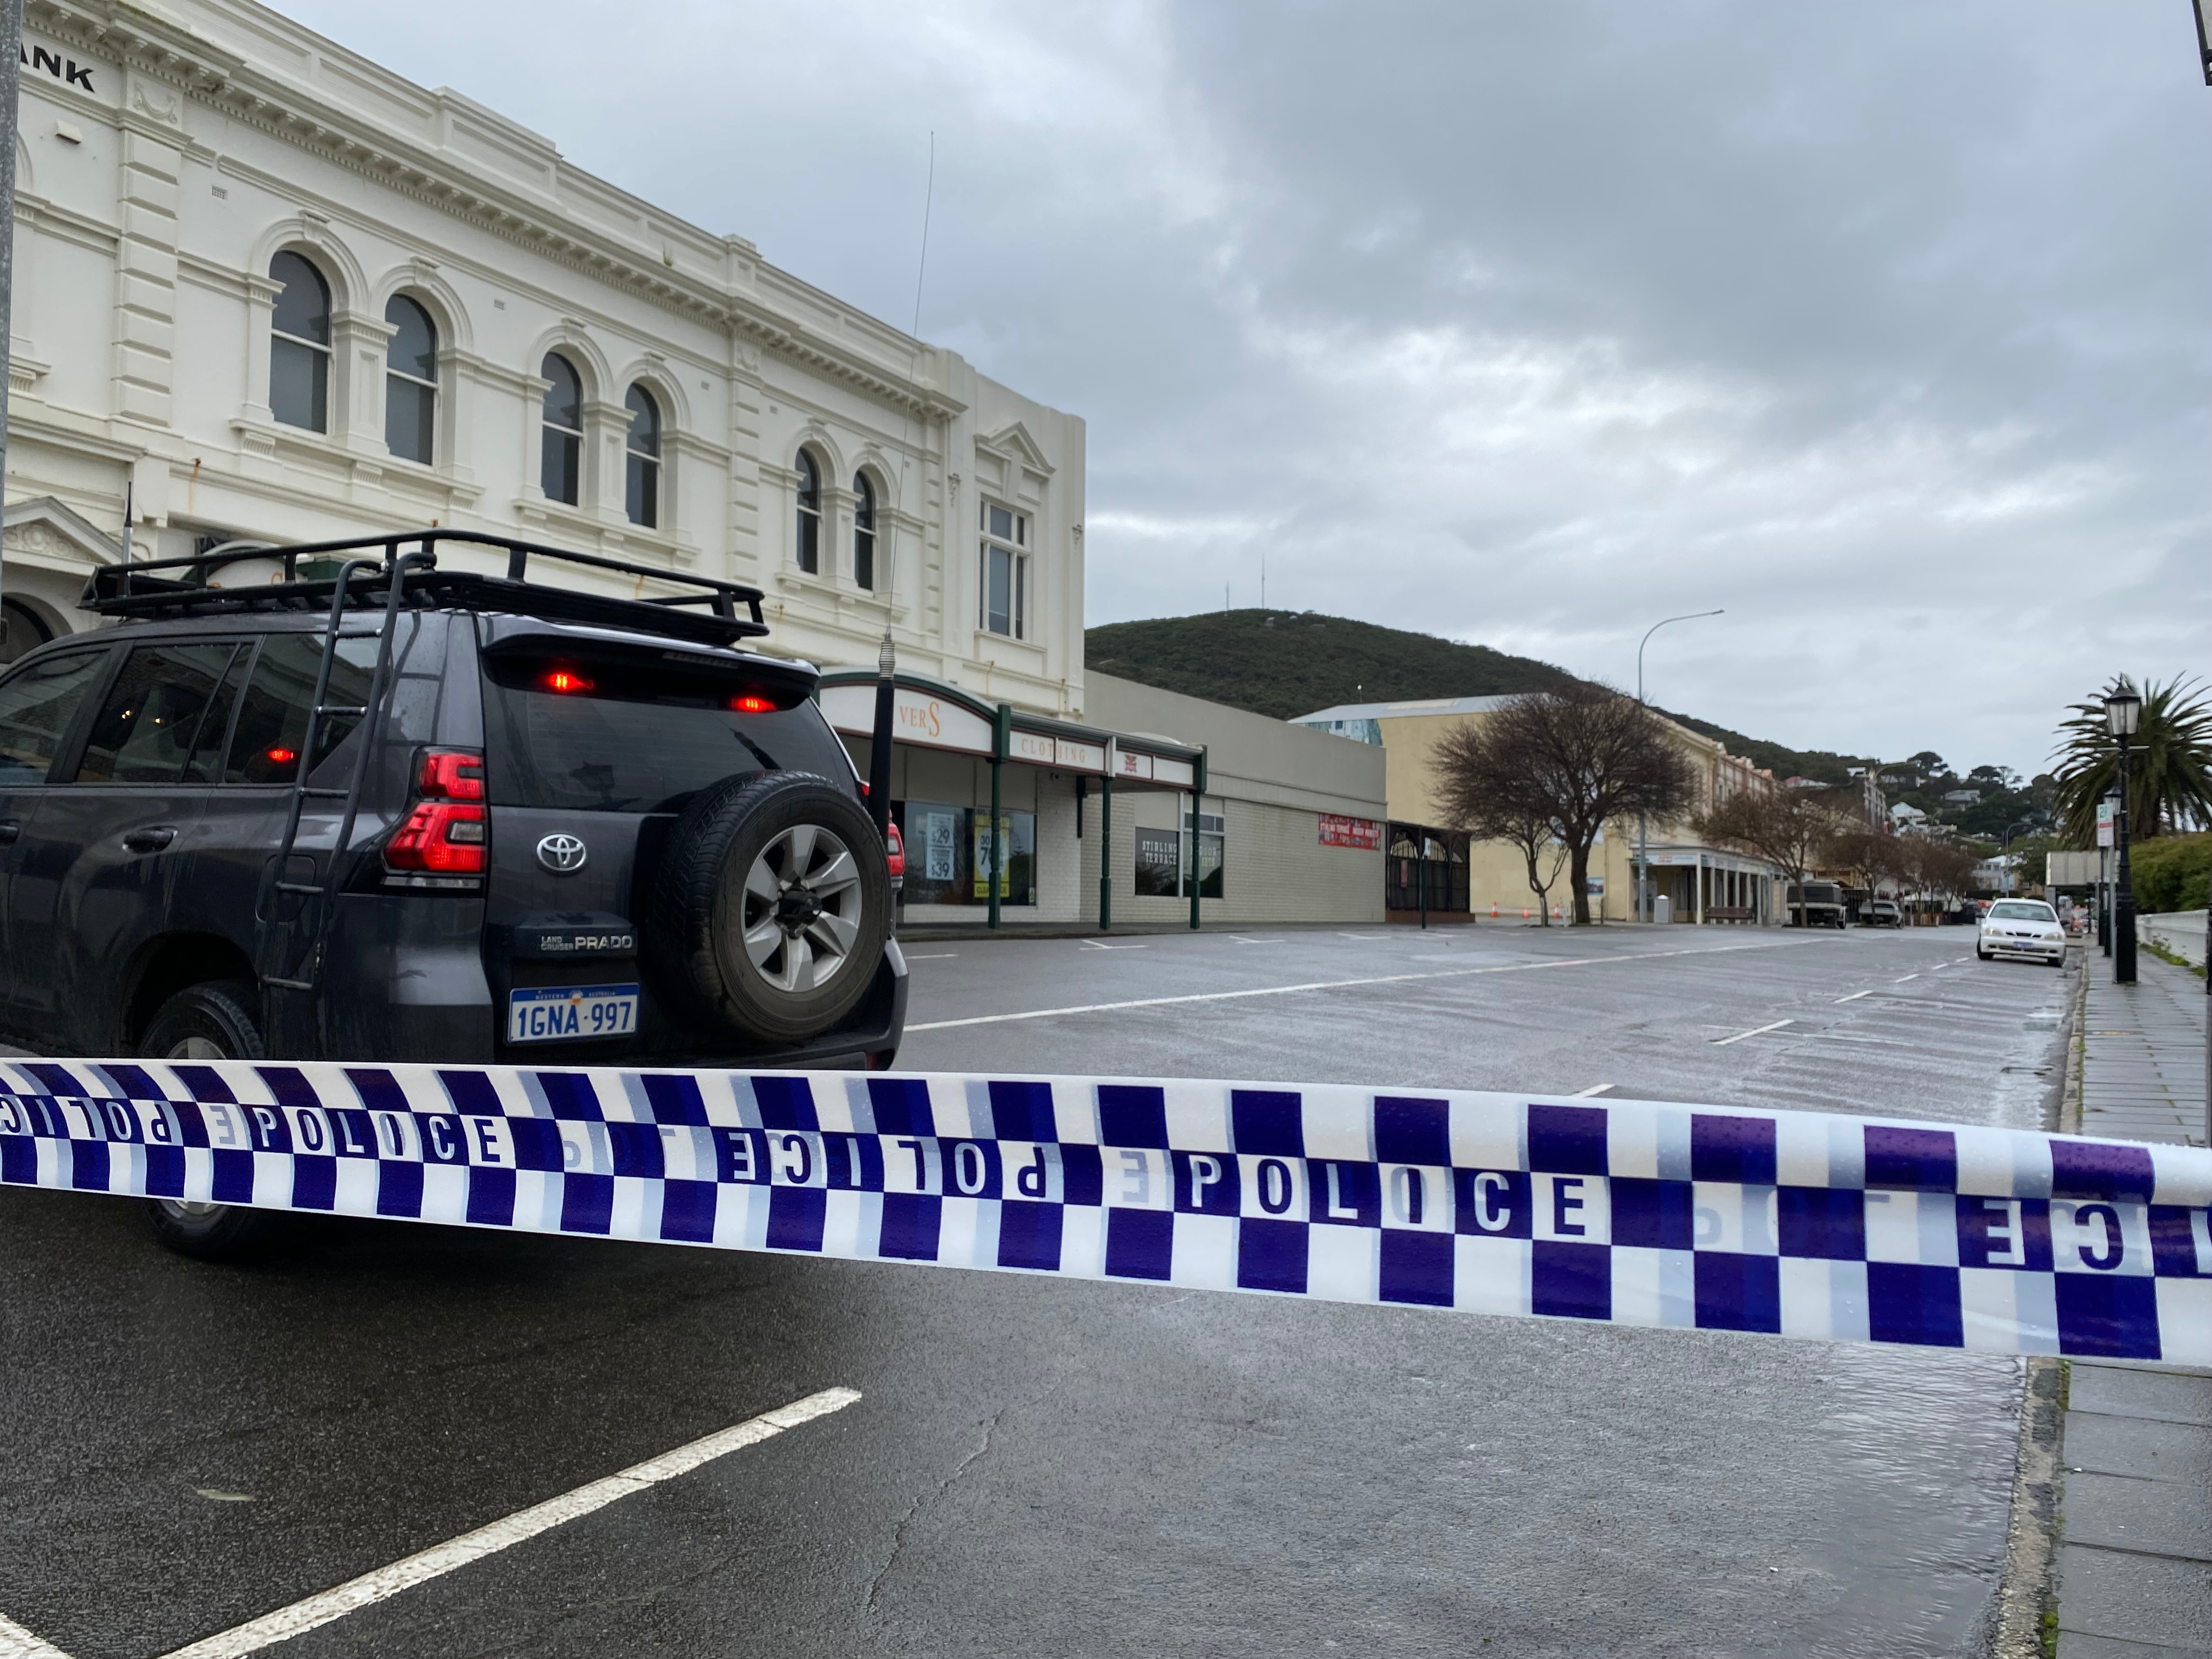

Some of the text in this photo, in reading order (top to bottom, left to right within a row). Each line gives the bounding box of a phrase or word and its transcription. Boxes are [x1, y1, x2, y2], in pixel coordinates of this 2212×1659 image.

[899, 701, 940, 737] VERS
[1021, 737, 1086, 763] CLOTHING
[1142, 840, 1177, 853] STIRLING
[1146, 852, 1177, 865] TERRACE
[575, 935, 633, 950] PRADO
